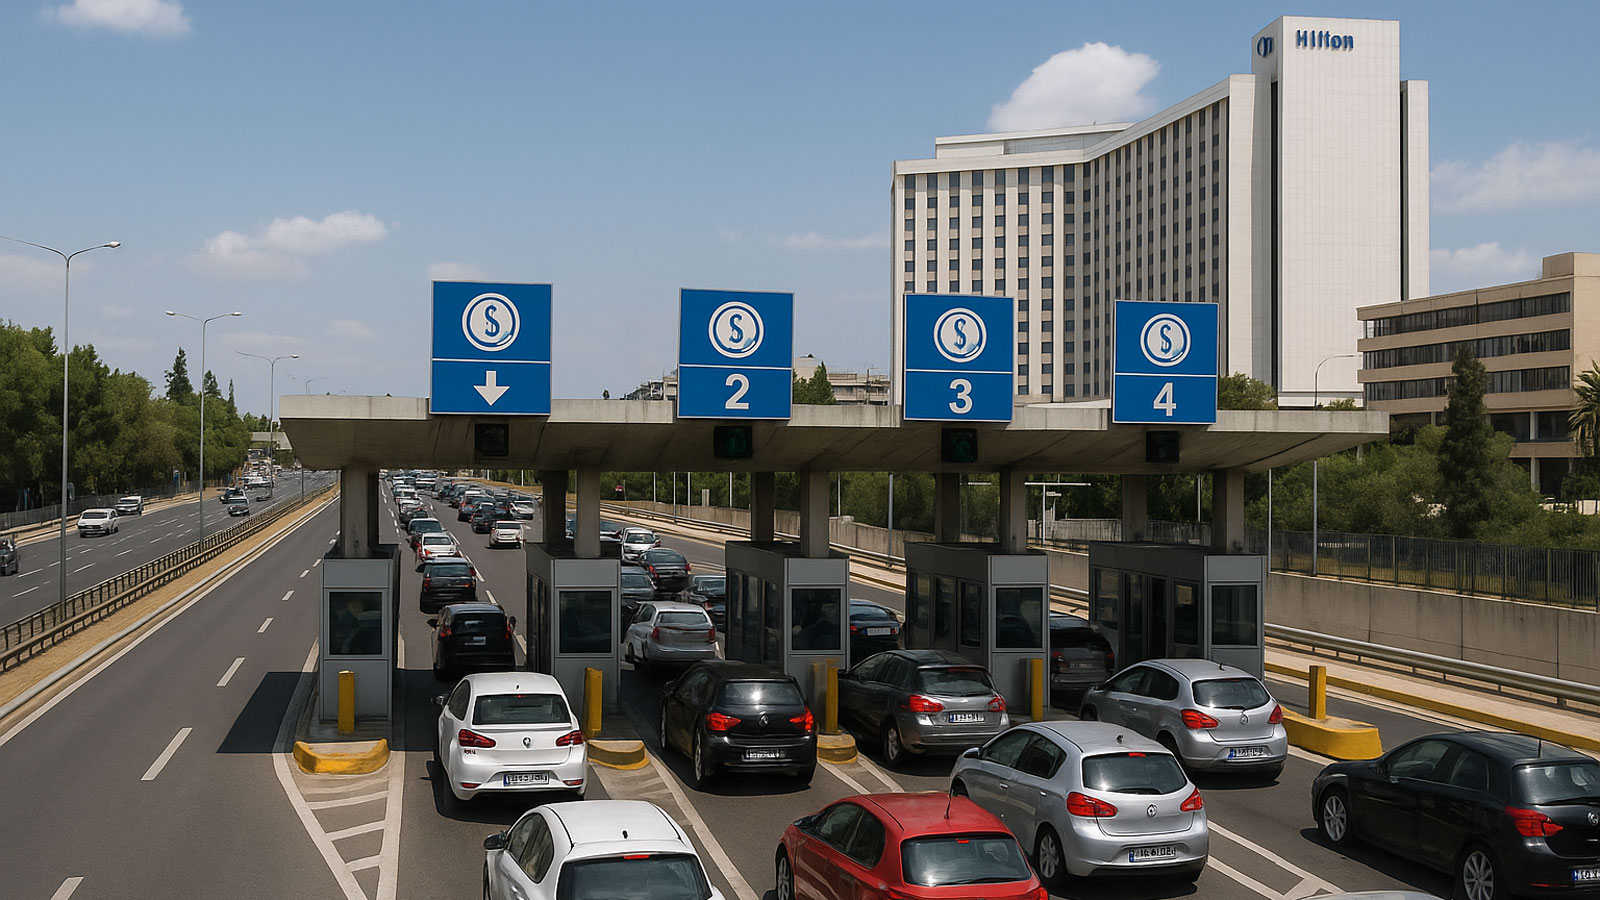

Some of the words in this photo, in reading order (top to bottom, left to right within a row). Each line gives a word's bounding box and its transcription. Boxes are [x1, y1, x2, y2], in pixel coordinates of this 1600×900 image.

[725, 373, 750, 410] 2
[948, 378, 973, 414] 3
[1153, 382, 1177, 417] 4
